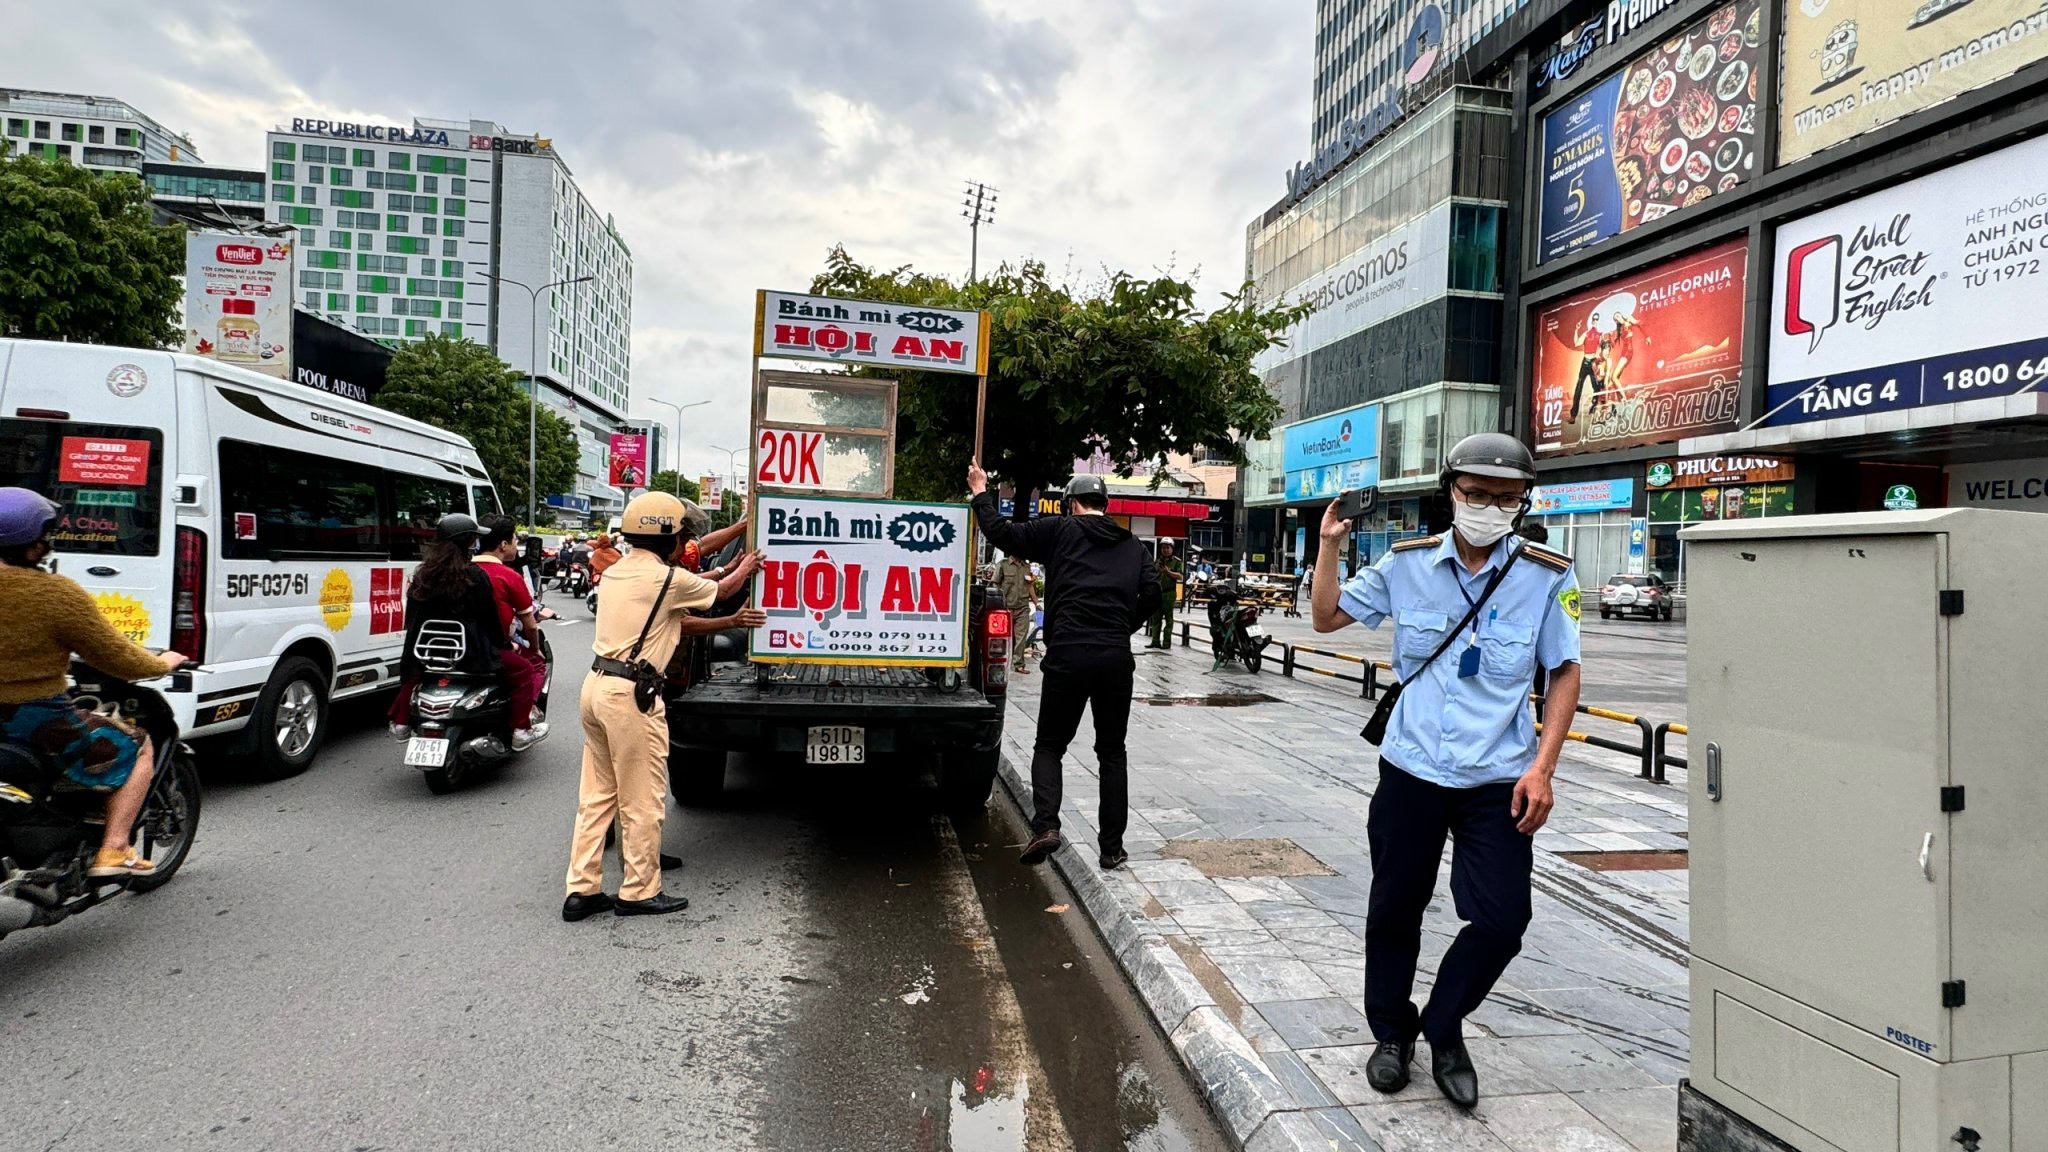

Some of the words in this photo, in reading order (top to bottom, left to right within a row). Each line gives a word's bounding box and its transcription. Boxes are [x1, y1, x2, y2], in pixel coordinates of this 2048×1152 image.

[1794, 94, 1855, 136] Where
[1861, 58, 1935, 107] happy
[292, 117, 384, 140] REPUBLIC
[388, 127, 450, 146] PLAZA
[468, 135, 535, 154] HDBank
[1286, 84, 1405, 201] VietinBank
[1568, 169, 1585, 222] 5
[1989, 193, 2047, 218] THỐNG
[1847, 213, 1911, 257] Wall
[1964, 223, 2006, 248] ANH
[2012, 212, 2048, 235] NG
[1964, 236, 2033, 268] CHUẨN
[1640, 266, 1731, 305] CALIFORNIA
[1845, 251, 1931, 291] Street
[1963, 268, 1989, 289] TỪ
[1993, 259, 2040, 282] 1972
[1370, 277, 1406, 300] technology
[1639, 294, 1683, 313] FITNESS
[1701, 280, 1731, 294] YOGA
[1845, 275, 1938, 330] English
[778, 299, 849, 320] Bánh
[859, 309, 892, 324] mì
[905, 315, 956, 331] 20K
[774, 324, 874, 354] HỘI
[892, 336, 963, 359] AN
[297, 366, 329, 391] POOL
[332, 379, 367, 401] ARENA
[1942, 363, 2009, 391] 1800
[1675, 380, 1736, 425] KHỎE
[1800, 377, 1873, 413] TẦNG
[1879, 378, 1898, 403] 4
[310, 412, 349, 429] DIESEL
[349, 423, 372, 435] TURBO
[1543, 401, 1562, 427] 02
[758, 431, 823, 485] 20K
[1302, 435, 1341, 455] VietinBank
[72, 462, 136, 471] INTERNATIONAL
[80, 471, 129, 480] EDUCATION
[1677, 457, 1723, 475] PHUC
[1965, 478, 2048, 501] WELC
[76, 516, 119, 531] Châu
[640, 516, 674, 525] CSGT
[768, 507, 840, 538] Bánh
[850, 513, 883, 539] mì
[896, 520, 947, 544] 20K
[761, 549, 862, 622] HỘI
[880, 565, 954, 614] AN
[829, 630, 872, 639] 0799
[879, 631, 911, 640] 079
[917, 633, 947, 641] 911
[829, 643, 872, 651] 0909
[878, 644, 911, 652] 867
[917, 645, 947, 653] 129
[214, 702, 240, 721] ESP
[821, 728, 852, 744] 51D
[1887, 1026, 1932, 1053] POSTEF
